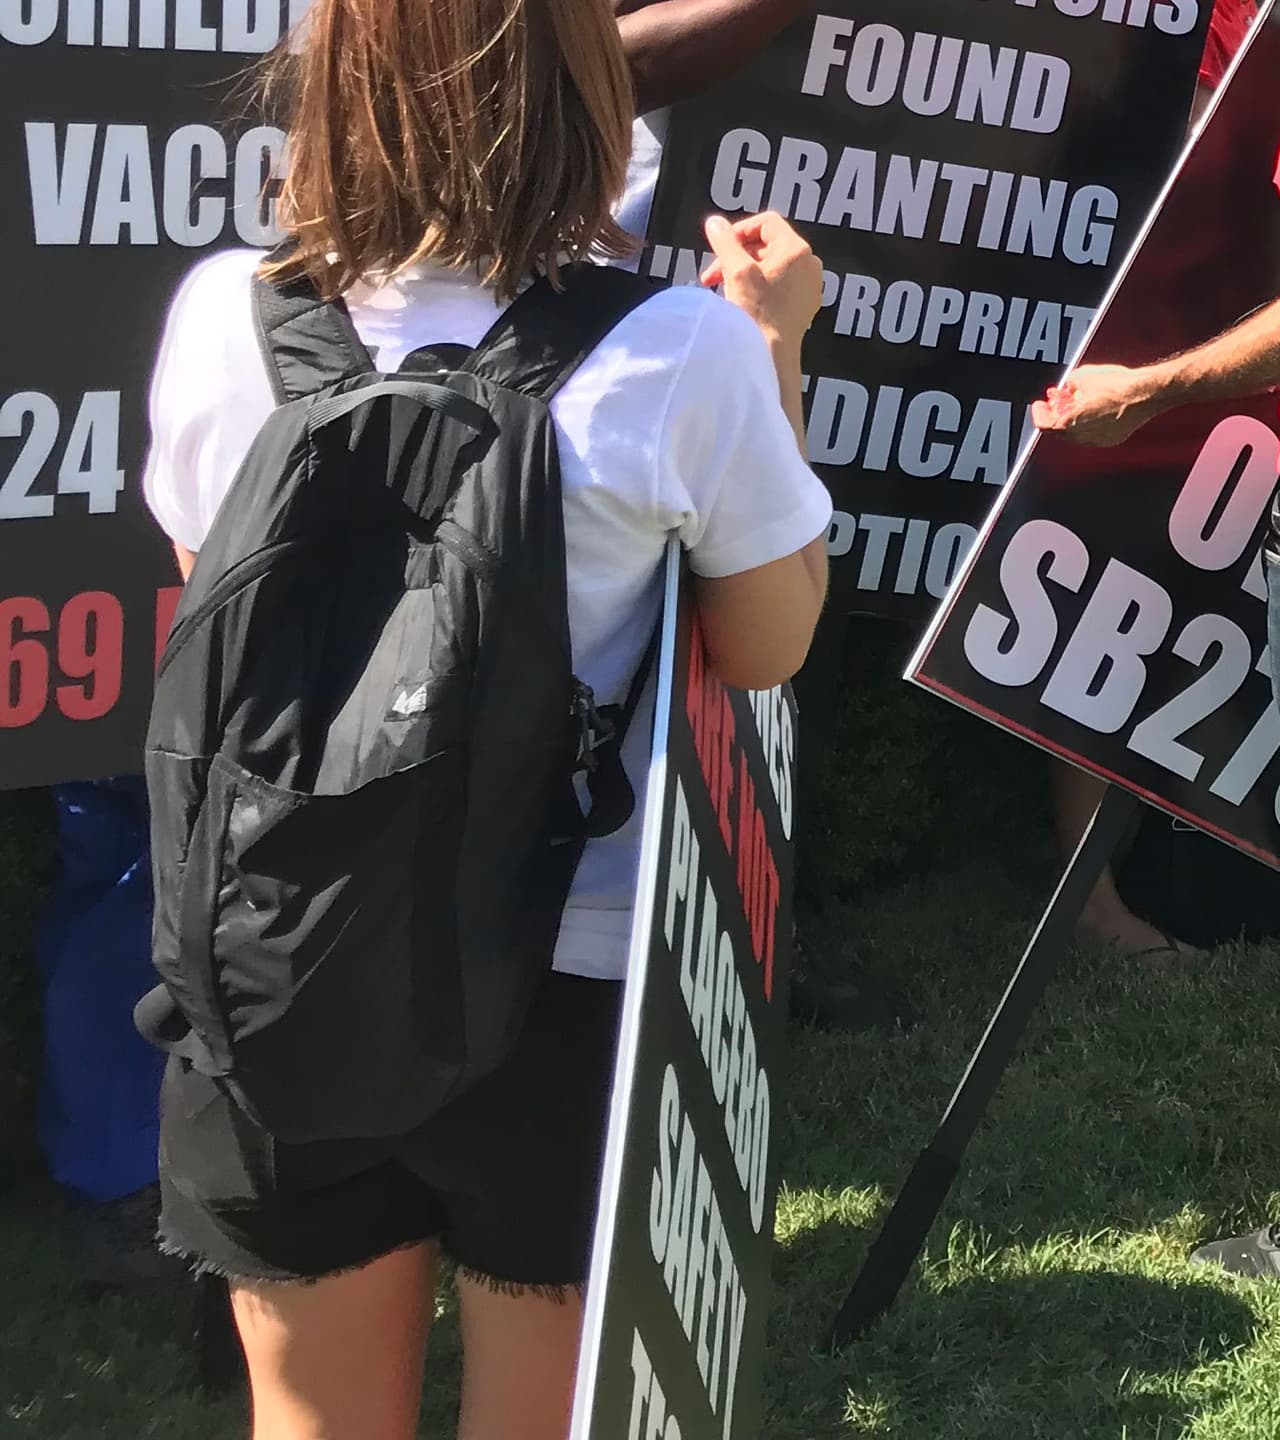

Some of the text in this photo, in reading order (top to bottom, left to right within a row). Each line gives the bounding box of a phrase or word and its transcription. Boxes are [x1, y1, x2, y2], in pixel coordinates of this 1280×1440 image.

[709, 127, 1119, 268] GRANTING
[800, 14, 1072, 136] FOUND
[663, 773, 771, 1237] PLACEBO
[738, 747, 781, 1006] NOT
[648, 1061, 748, 1440] SAFETY
